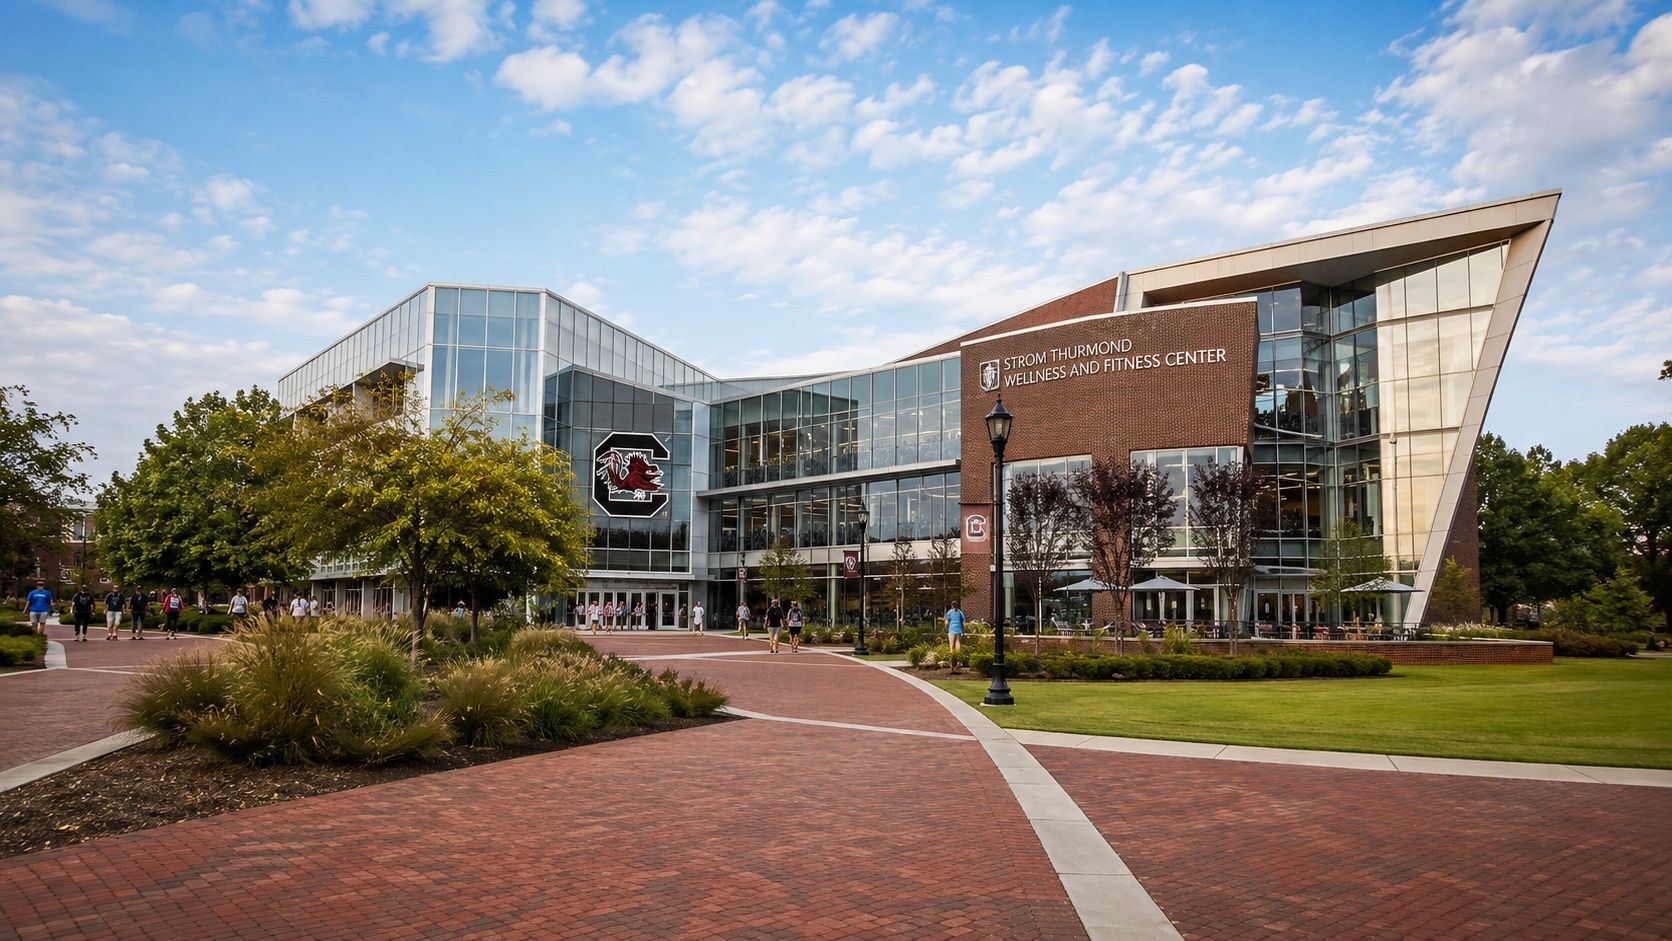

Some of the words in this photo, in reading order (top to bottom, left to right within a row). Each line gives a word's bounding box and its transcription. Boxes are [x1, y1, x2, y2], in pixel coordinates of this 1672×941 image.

[1004, 352, 1047, 371] STROM
[1050, 339, 1132, 362] THURMOND
[1004, 365, 1066, 388] WELLNESS
[1069, 361, 1099, 378] AND
[1104, 353, 1160, 373] FITNESS
[1165, 349, 1227, 367] CENTER
